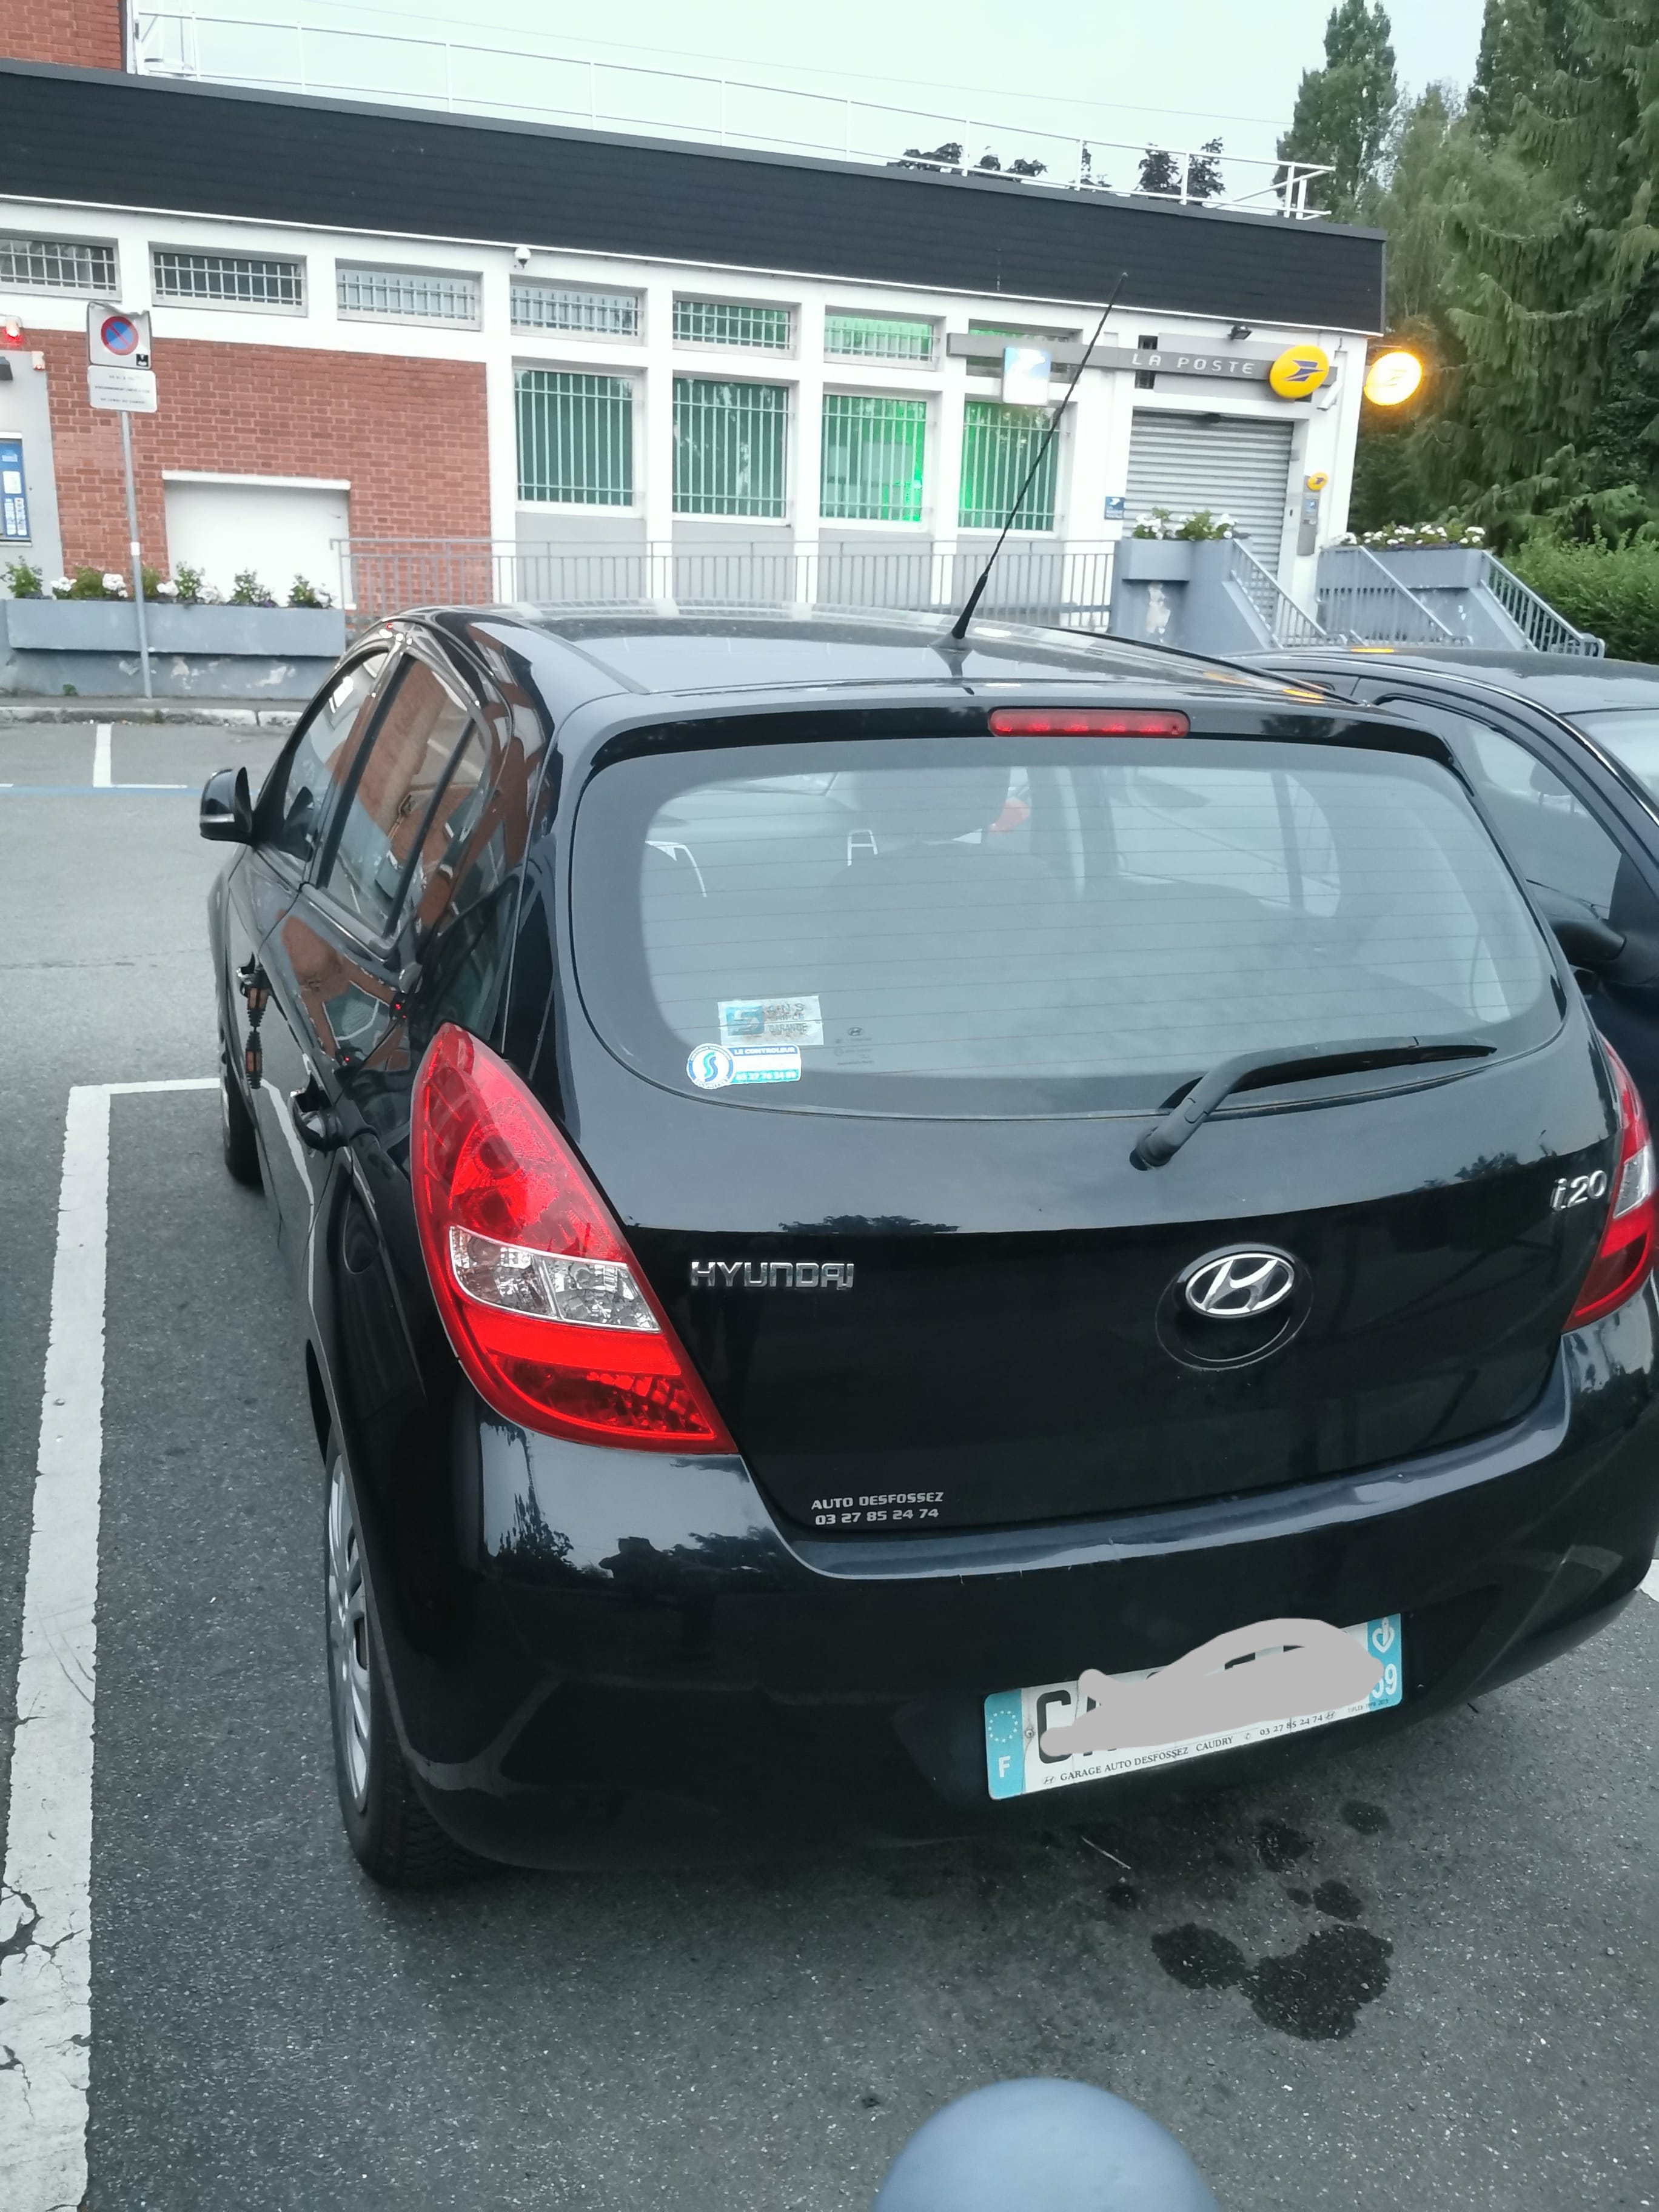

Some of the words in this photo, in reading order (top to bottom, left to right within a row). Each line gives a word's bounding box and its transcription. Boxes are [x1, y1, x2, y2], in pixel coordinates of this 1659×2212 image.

[1132, 353, 1161, 366] LA
[1176, 357, 1255, 374] POSTE
[1550, 1170, 1607, 1210] i20
[691, 1261, 854, 1290] HYUNDAI
[811, 1497, 854, 1510] AUTO
[859, 1492, 944, 1506] DESFOSSEZ
[815, 1514, 836, 1525] 03
[841, 1512, 862, 1523] 27
[866, 1510, 887, 1521] 85
[893, 1509, 914, 1520] 24
[919, 1508, 939, 1519] 74
[1060, 1766, 1102, 1781] GARAGE
[1104, 1760, 1131, 1772] AUTO
[1134, 1746, 1189, 1766] DESFOSSEZ
[1196, 1735, 1234, 1752] CAUDRY
[1273, 1724, 1284, 1732] 27
[1286, 1721, 1296, 1729] 85
[1299, 1717, 1310, 1726] 24
[1312, 1714, 1322, 1723] 74
[999, 1755, 1011, 1777] F
